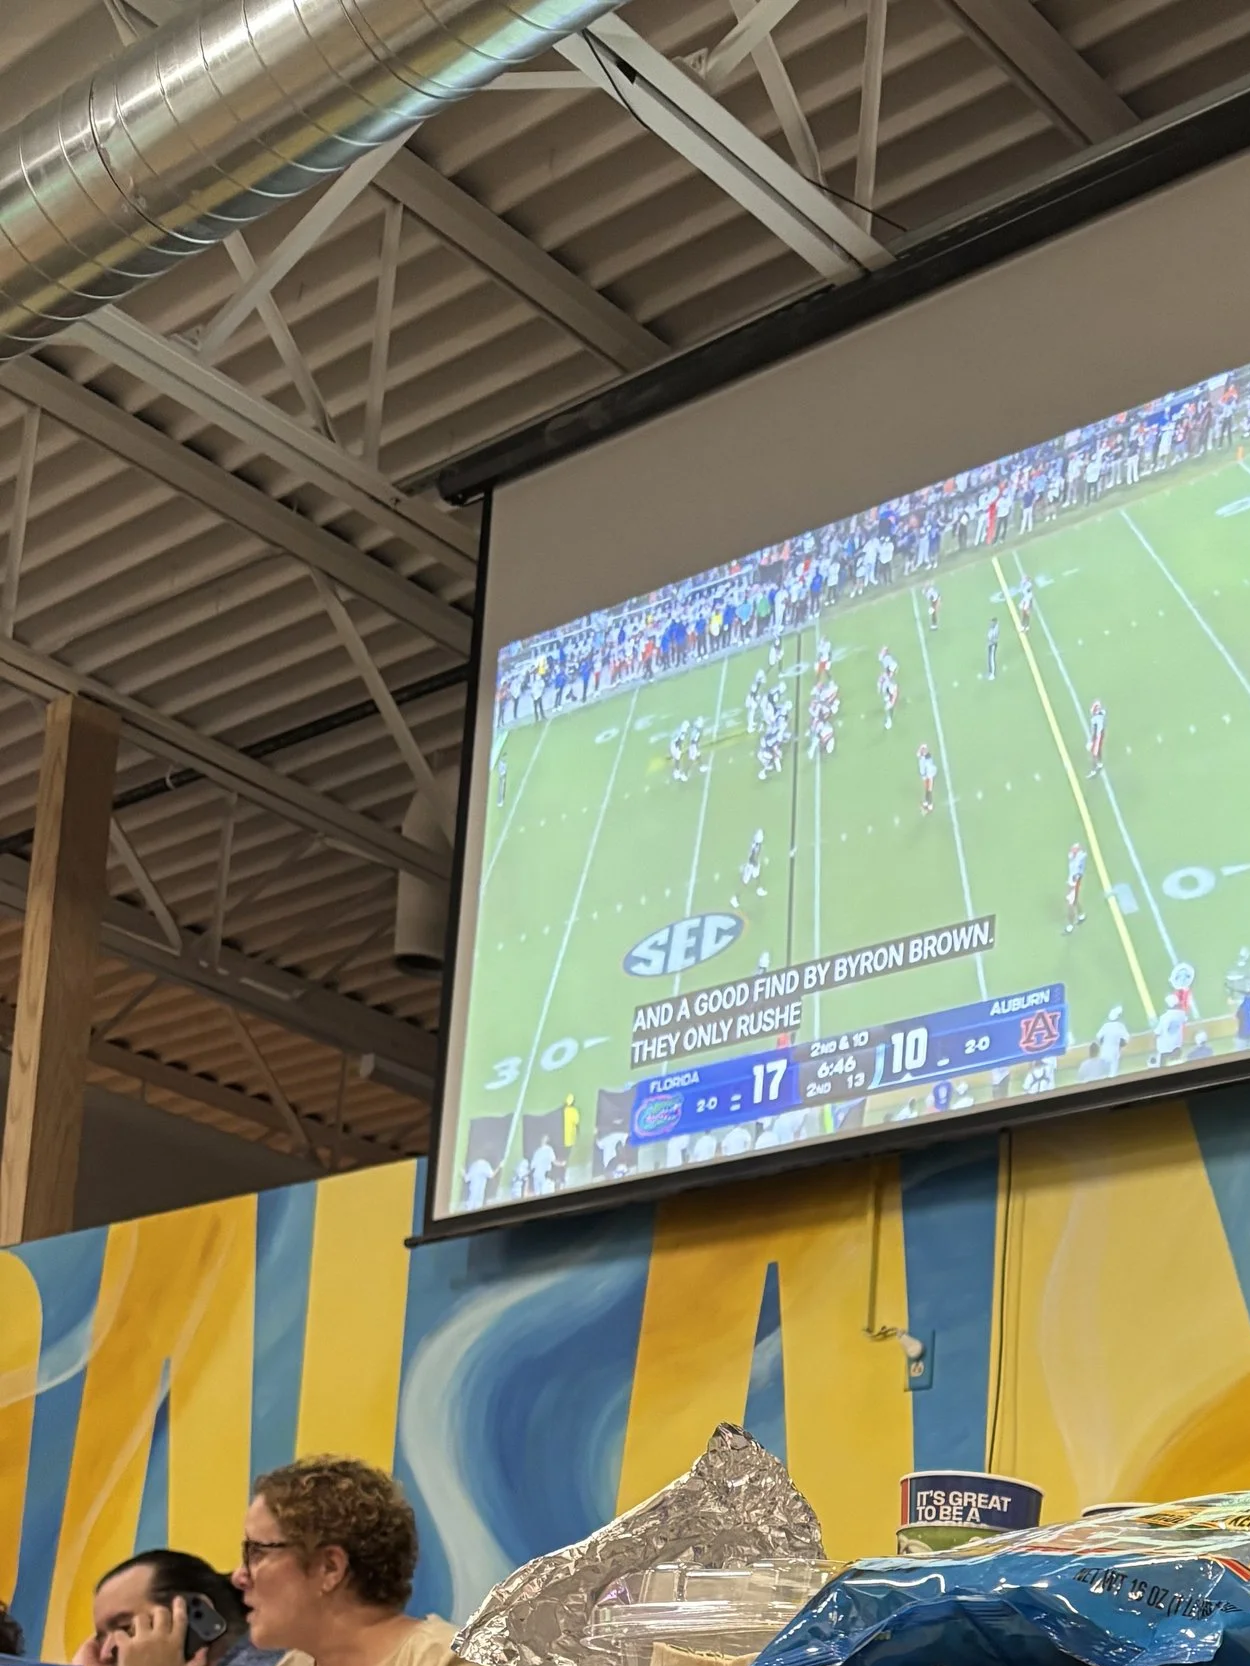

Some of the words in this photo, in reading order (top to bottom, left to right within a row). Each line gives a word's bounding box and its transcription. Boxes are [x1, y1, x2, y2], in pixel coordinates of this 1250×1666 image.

[630, 915, 738, 976] SEC
[632, 1004, 674, 1032] AND
[676, 999, 692, 1021] A
[693, 982, 750, 1017] GOOD
[753, 971, 800, 1002] FIND
[803, 963, 828, 991] BY
[833, 943, 905, 981] BYRON
[908, 921, 995, 964] BROWN.
[989, 988, 1051, 1017] AUBURN
[631, 1036, 678, 1064] THEY
[683, 1017, 737, 1051] ONLY
[739, 1001, 802, 1038] RUSHE
[809, 1040, 837, 1058] 2ND
[838, 1035, 851, 1052] &
[853, 1031, 869, 1048] 10
[890, 1026, 929, 1074] 10
[752, 1058, 788, 1105] 17
[816, 1055, 857, 1079] 6:46
[649, 1071, 700, 1094] FLORIDA
[806, 1081, 832, 1098] 2ND
[846, 1071, 865, 1089] 13
[916, 1489, 946, 1507] IT'S
[948, 1490, 1012, 1513] GREAT
[916, 1506, 937, 1521] TO
[939, 1506, 964, 1522] BE
[966, 1507, 981, 1522] A
[1130, 1578, 1148, 1601] 16
[1148, 1585, 1170, 1609] OZ
